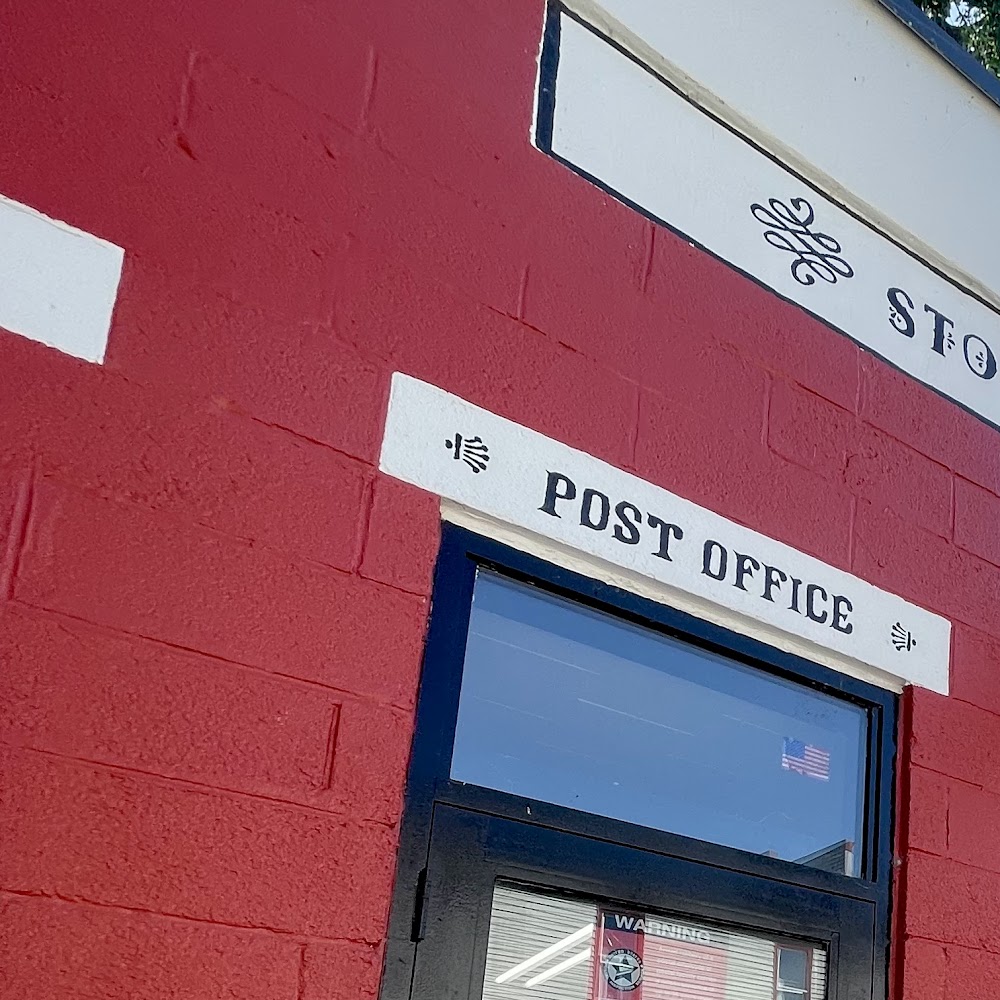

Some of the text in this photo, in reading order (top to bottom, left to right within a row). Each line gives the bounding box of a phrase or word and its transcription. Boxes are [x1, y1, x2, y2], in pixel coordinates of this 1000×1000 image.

[537, 470, 854, 635] POST OFFICE
[615, 914, 711, 944] WARNING
